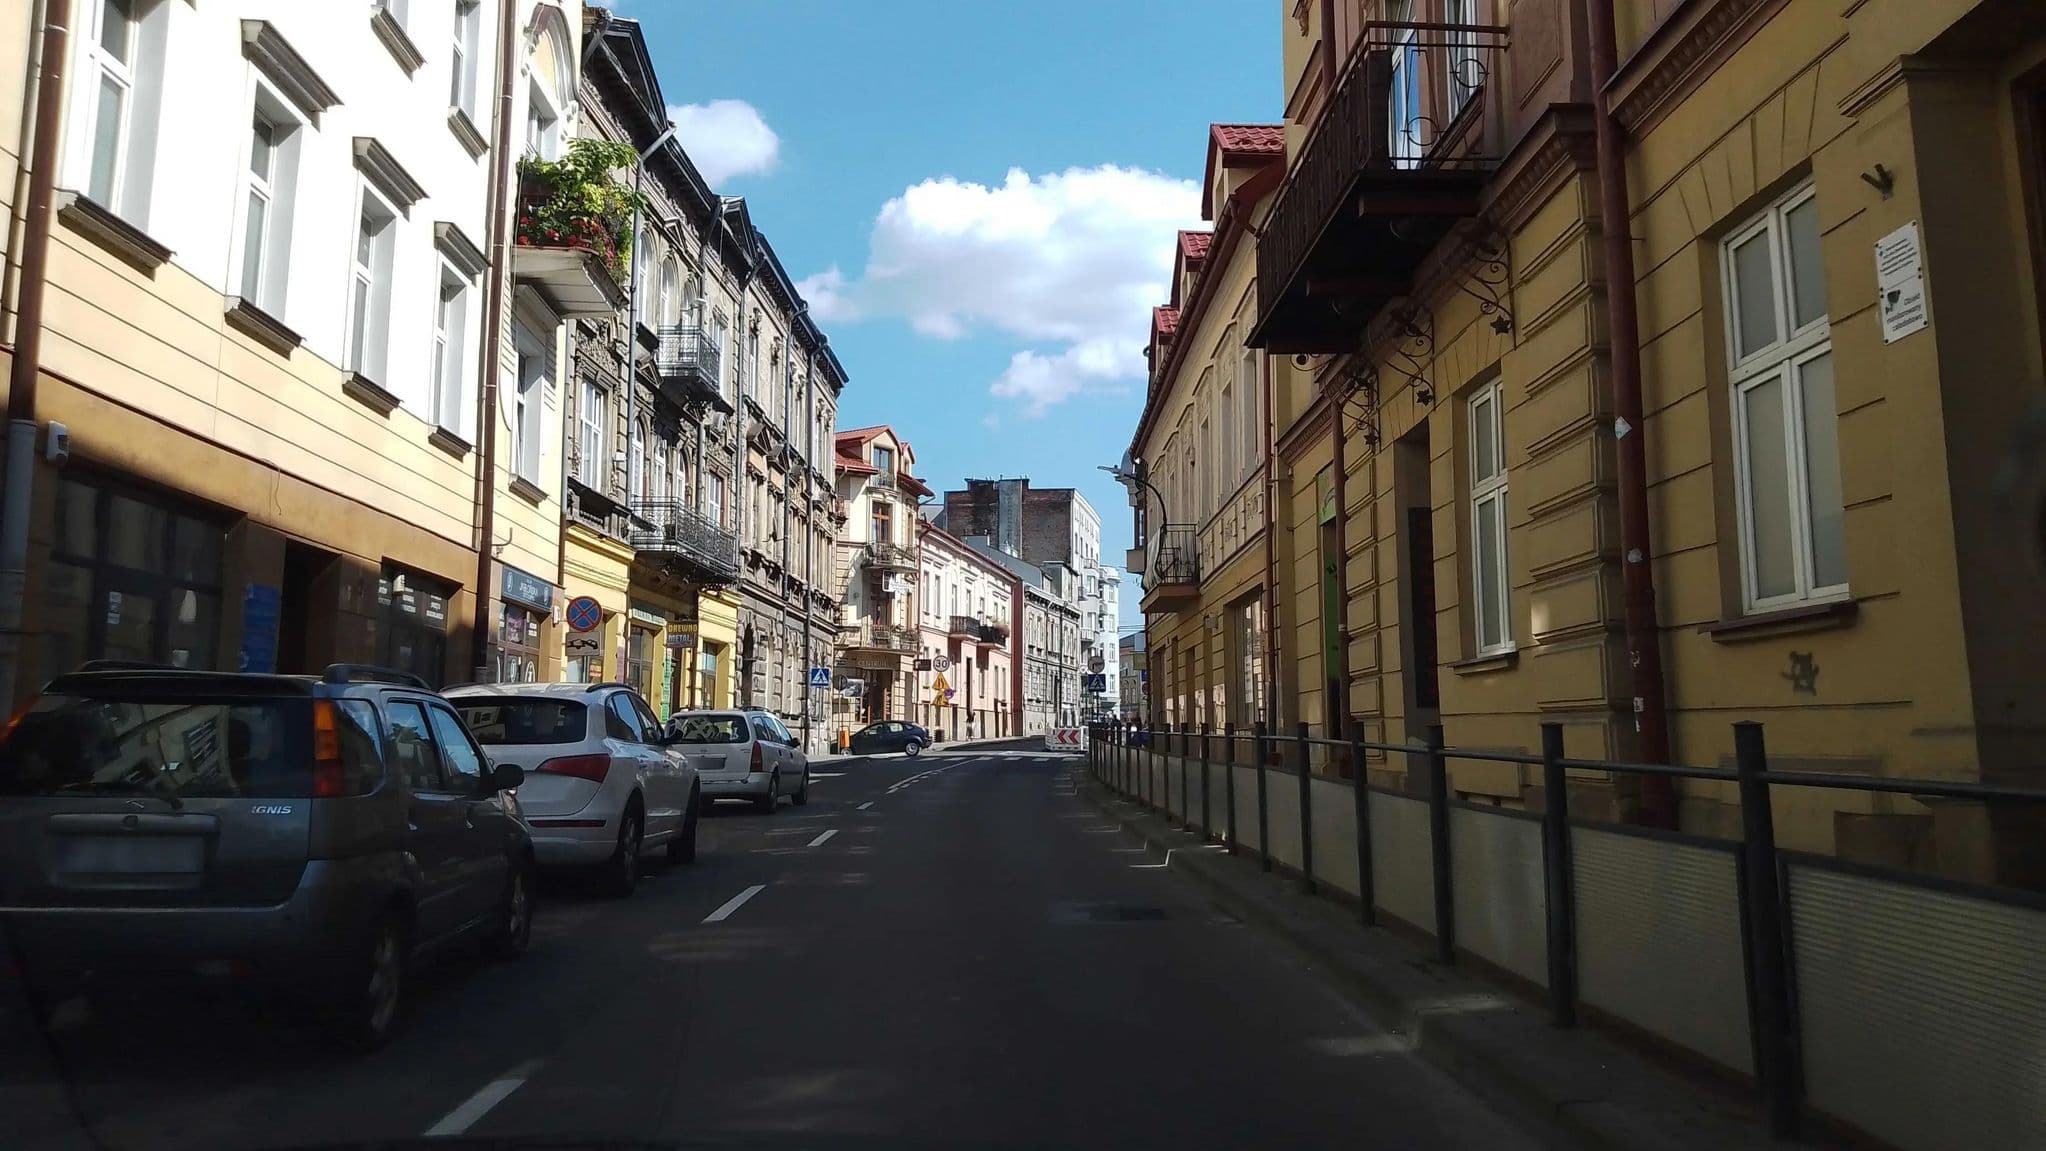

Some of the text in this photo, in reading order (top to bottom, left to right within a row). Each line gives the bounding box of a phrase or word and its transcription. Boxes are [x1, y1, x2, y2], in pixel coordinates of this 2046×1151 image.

[668, 623, 698, 633] DREWNO
[935, 659, 948, 668] 30
[251, 806, 292, 814] IGNIS
